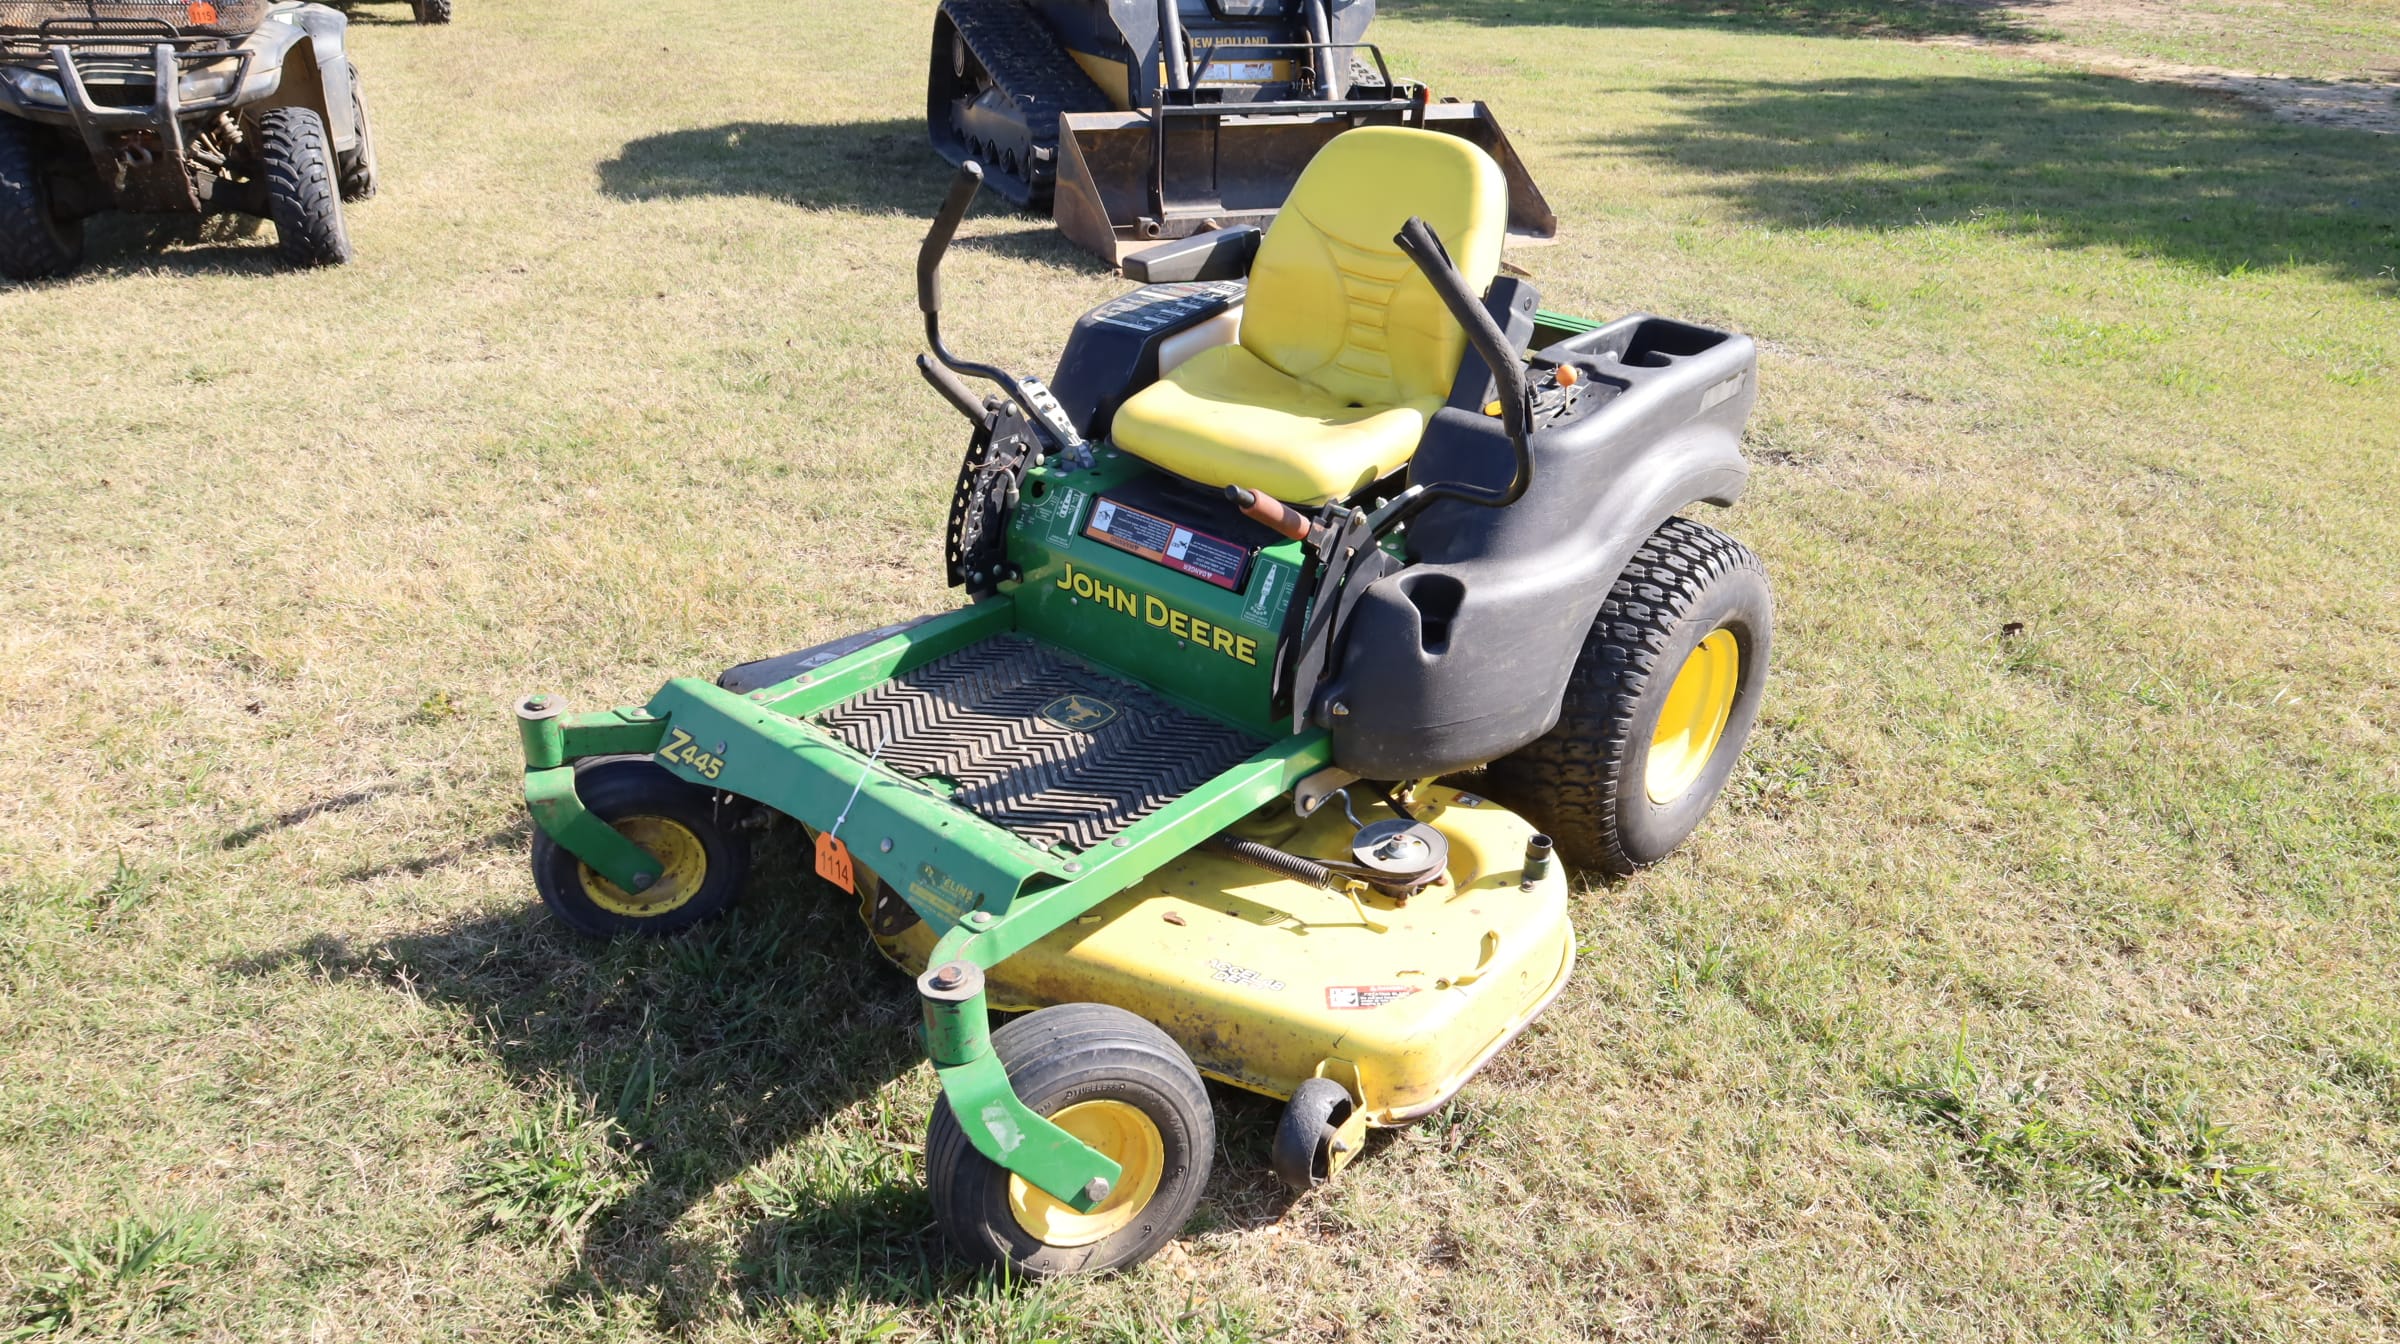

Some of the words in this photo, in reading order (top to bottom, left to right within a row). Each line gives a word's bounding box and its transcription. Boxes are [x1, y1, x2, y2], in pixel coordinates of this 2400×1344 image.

[190, 10, 212, 22] 1115
[1056, 561, 1138, 619] JOHN
[1144, 594, 1258, 666] DEERE
[659, 727, 725, 779] Z445
[821, 850, 849, 885] 1114
